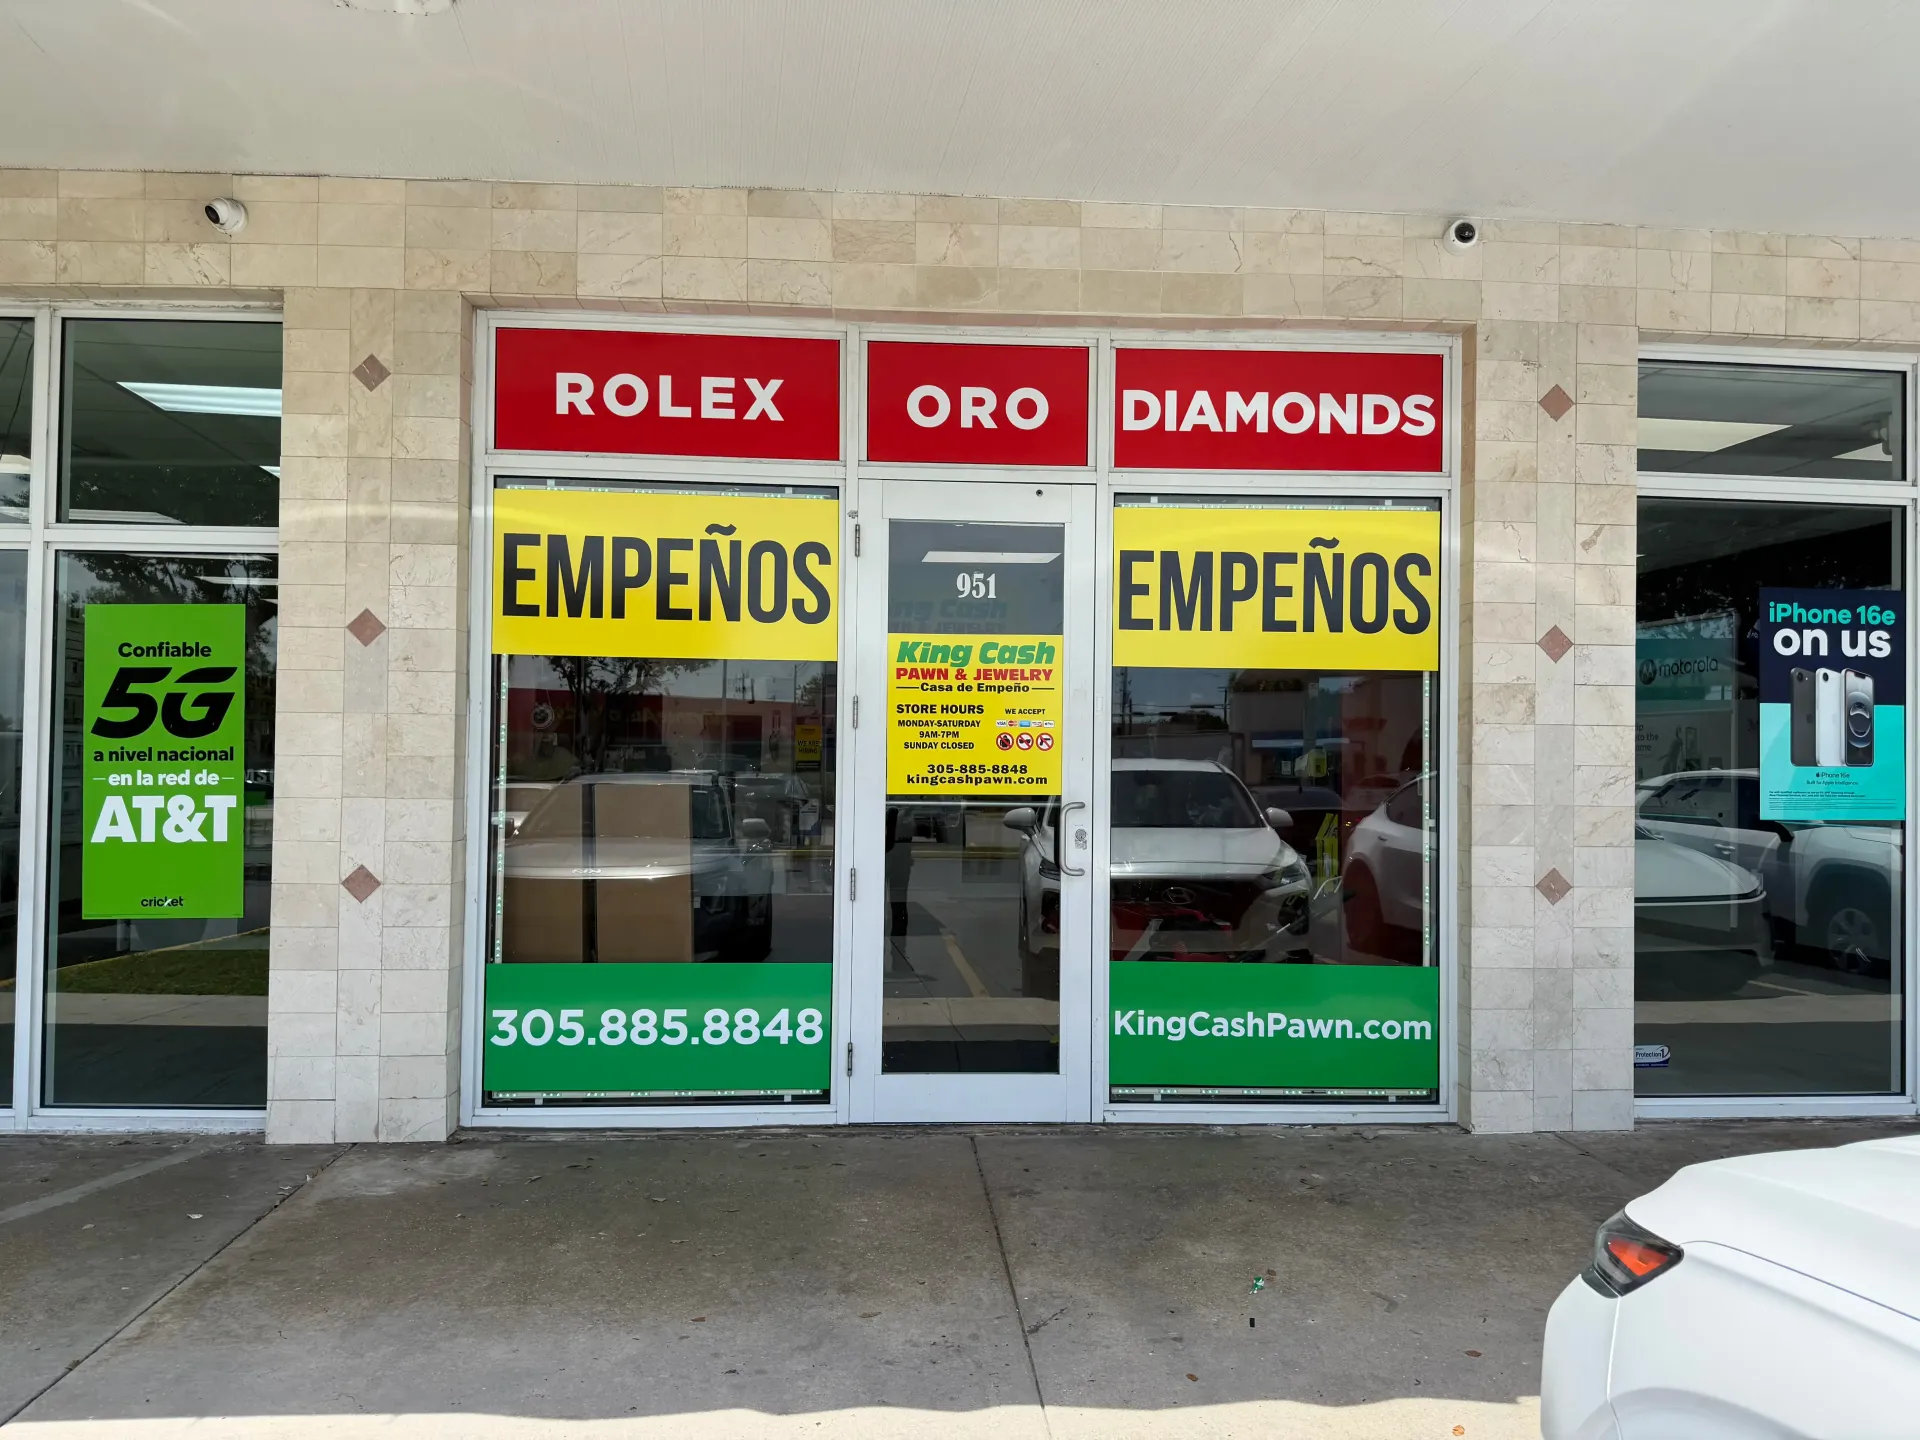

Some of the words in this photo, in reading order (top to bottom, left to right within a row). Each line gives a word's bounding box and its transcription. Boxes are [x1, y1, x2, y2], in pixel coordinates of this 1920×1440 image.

[556, 372, 784, 422] ROLEX
[906, 384, 1049, 431] ORO
[1122, 389, 1436, 437] DIAMONDS
[502, 523, 832, 625] EMPEÑOS
[956, 571, 997, 599] 951
[1118, 536, 1432, 635] EMPEÑOS
[1769, 602, 1851, 624] iPhone
[1856, 605, 1896, 626] 16e
[117, 641, 212, 658] Confiable
[1773, 628, 1828, 656] on
[1841, 630, 1891, 658] us
[896, 641, 974, 668] King
[978, 641, 1056, 665] Cash
[896, 667, 949, 681] PAWN
[954, 668, 967, 681] &
[973, 668, 1053, 681] JEWELRY
[1659, 656, 1719, 677] motorola
[920, 682, 953, 692] Casa
[957, 683, 973, 692] de
[976, 682, 1030, 694] Empeño
[90, 666, 238, 739] 5G
[896, 703, 938, 714] STORE
[940, 704, 985, 715] HOURS
[897, 719, 981, 728] MONDAY-SATURDAY
[919, 730, 960, 739] 9AM-7PM
[93, 750, 105, 762] a
[108, 745, 153, 762] nivel
[157, 745, 234, 762] nacional
[903, 741, 939, 750] SUNDAY
[940, 741, 976, 751] CLOSED
[108, 773, 133, 786] en
[136, 769, 153, 786] la
[158, 769, 190, 786] red
[194, 769, 220, 786] de
[906, 774, 1048, 786] kingcashpawn.com
[927, 764, 1028, 775] 305-885-8848
[90, 794, 237, 843] AT&T
[140, 895, 185, 908] cricket
[490, 1008, 824, 1048] 305.885.8848
[1114, 1009, 1432, 1043] KingCashPawn.com
